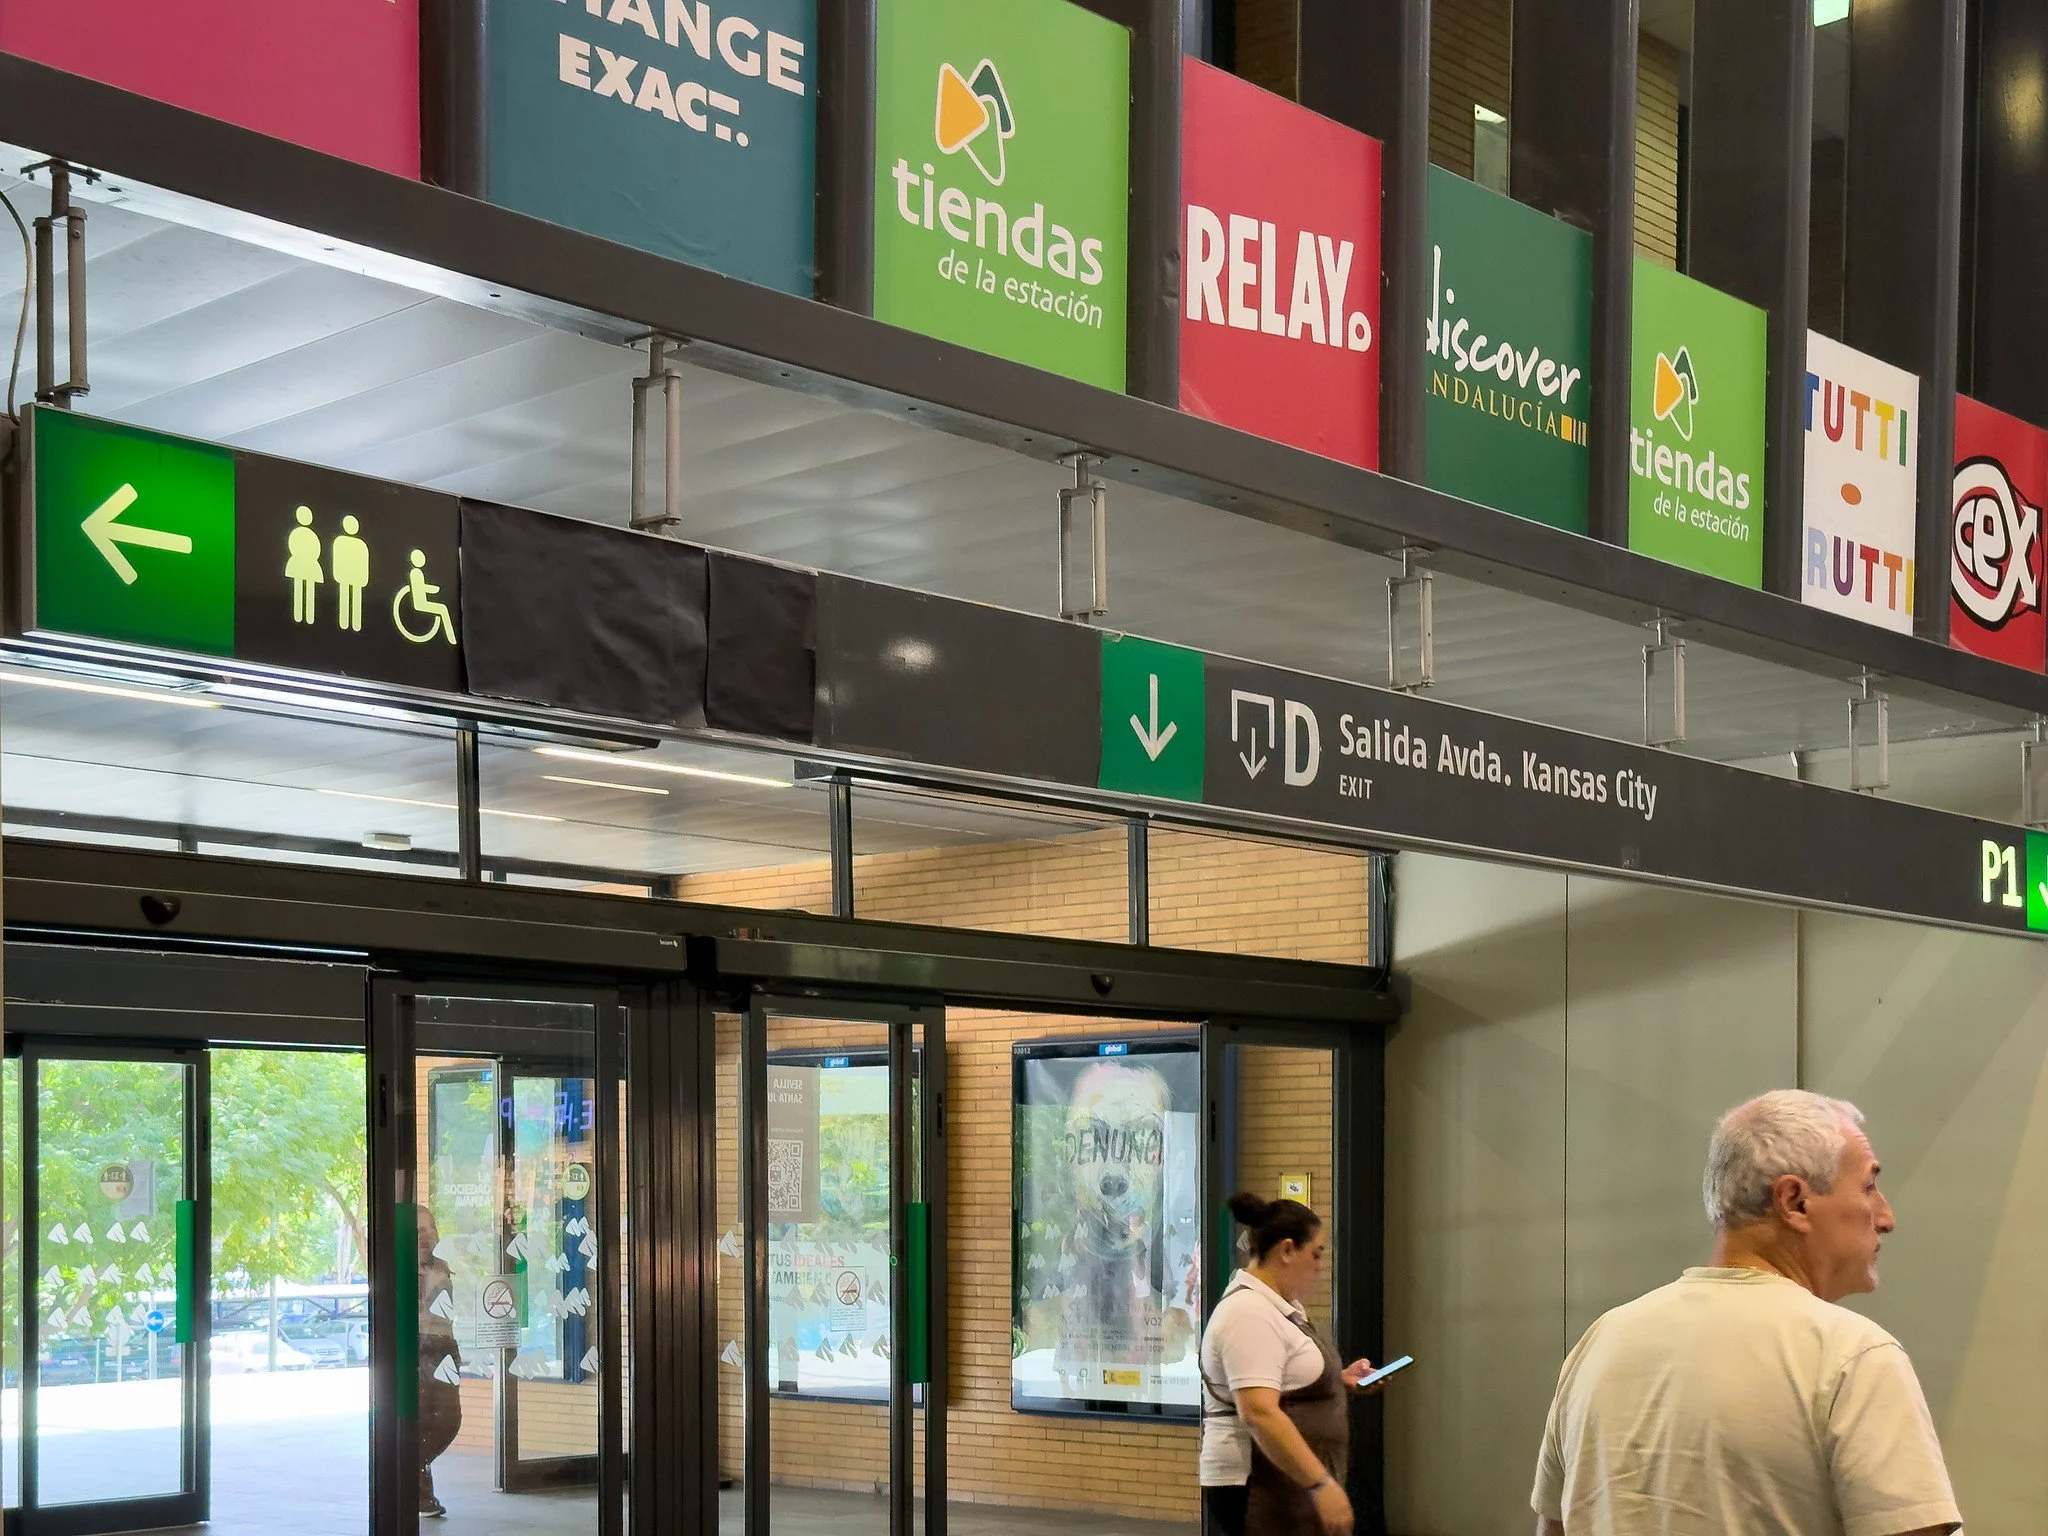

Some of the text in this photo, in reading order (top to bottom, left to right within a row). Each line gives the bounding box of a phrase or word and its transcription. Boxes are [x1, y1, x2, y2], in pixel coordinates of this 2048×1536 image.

[892, 157, 1103, 286] tiendas
[938, 248, 1103, 329] de la estación
[1426, 244, 1581, 405] discover
[1426, 369, 1558, 437] NDALUCÍA
[1804, 371, 1908, 467] TUTTI
[1630, 426, 1750, 510] tiendas
[1653, 491, 1749, 542] de la estación
[1807, 527, 1914, 617] RUTTI
[1284, 699, 1321, 788] D
[1339, 713, 1658, 821] Salida Avda. Kansas City
[1339, 774, 1374, 800] EXIT
[1981, 840, 2024, 909] P1
